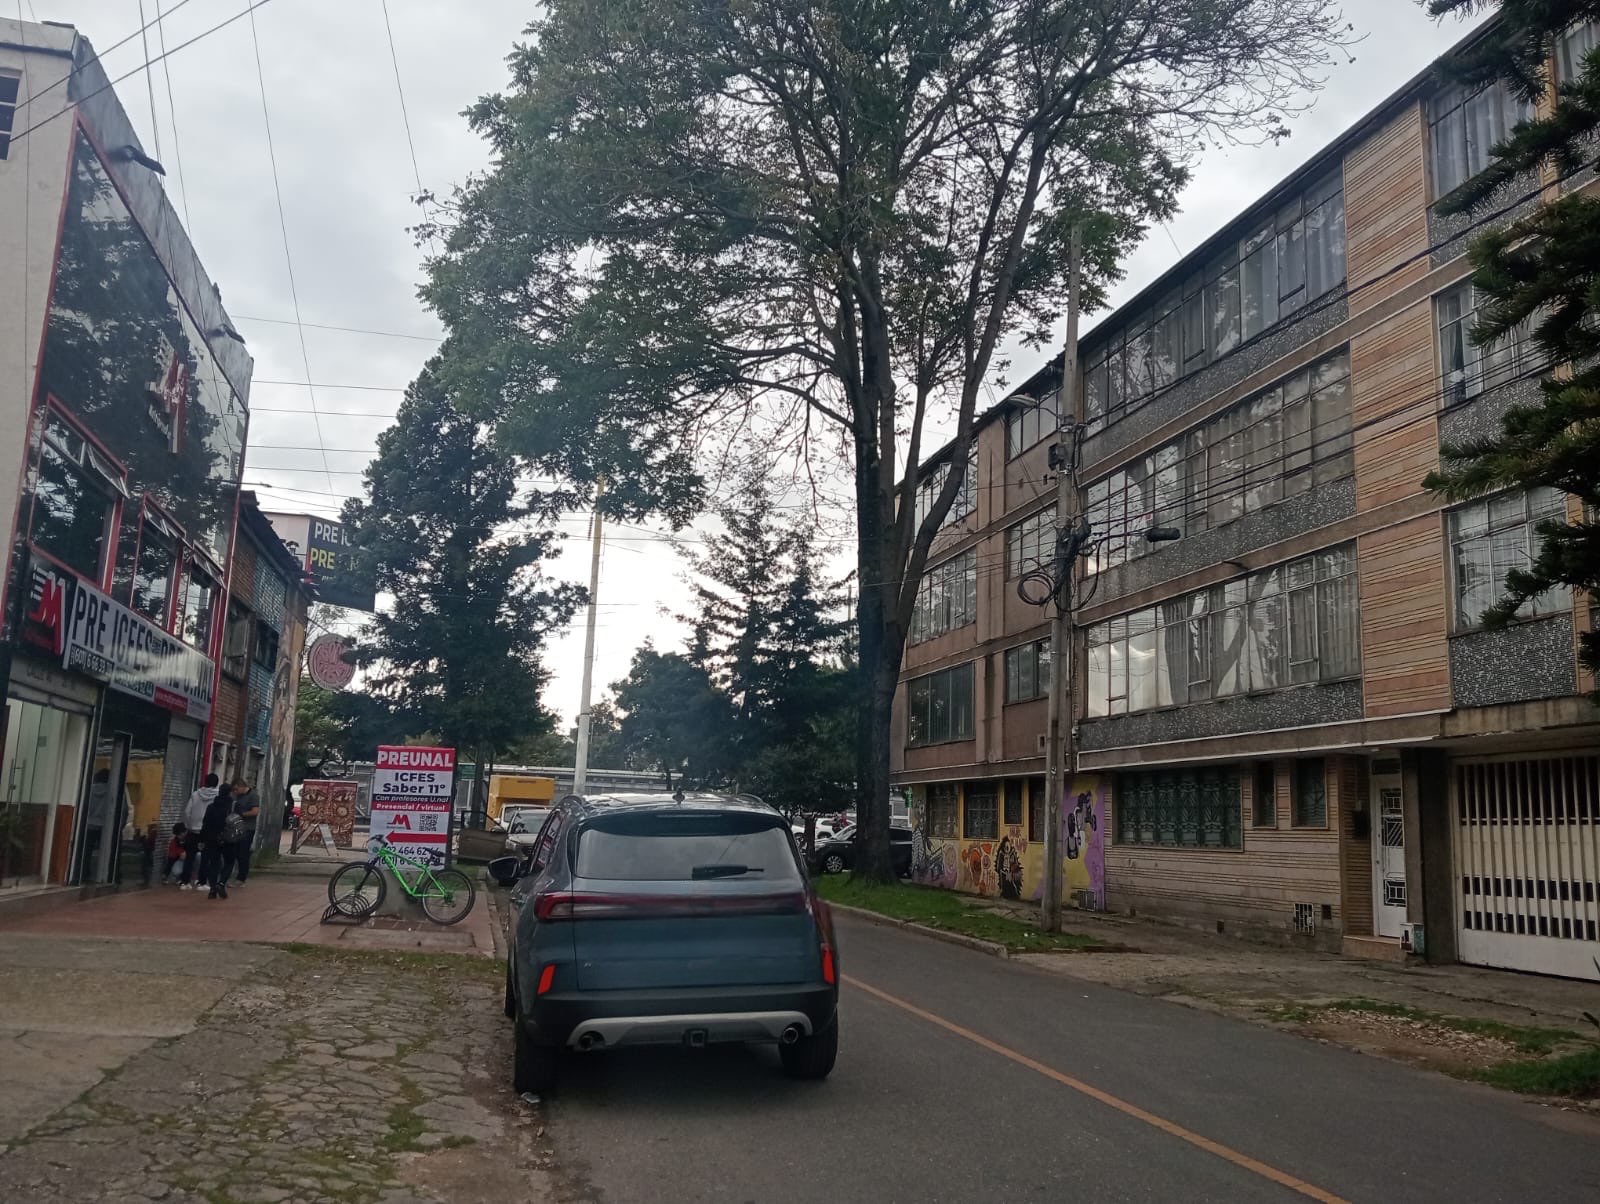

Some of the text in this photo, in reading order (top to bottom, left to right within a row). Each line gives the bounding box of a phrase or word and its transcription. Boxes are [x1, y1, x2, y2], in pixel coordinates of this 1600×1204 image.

[314, 521, 338, 544] PRE
[310, 547, 336, 570] PRE
[72, 585, 109, 654] PRE
[110, 608, 153, 671] ICFES
[377, 751, 453, 767] PREUNAL
[395, 772, 435, 782] ICFES
[383, 783, 424, 793] Saber
[376, 803, 415, 811] Presencial
[421, 804, 445, 812] virtual
[398, 846, 415, 856] 464
